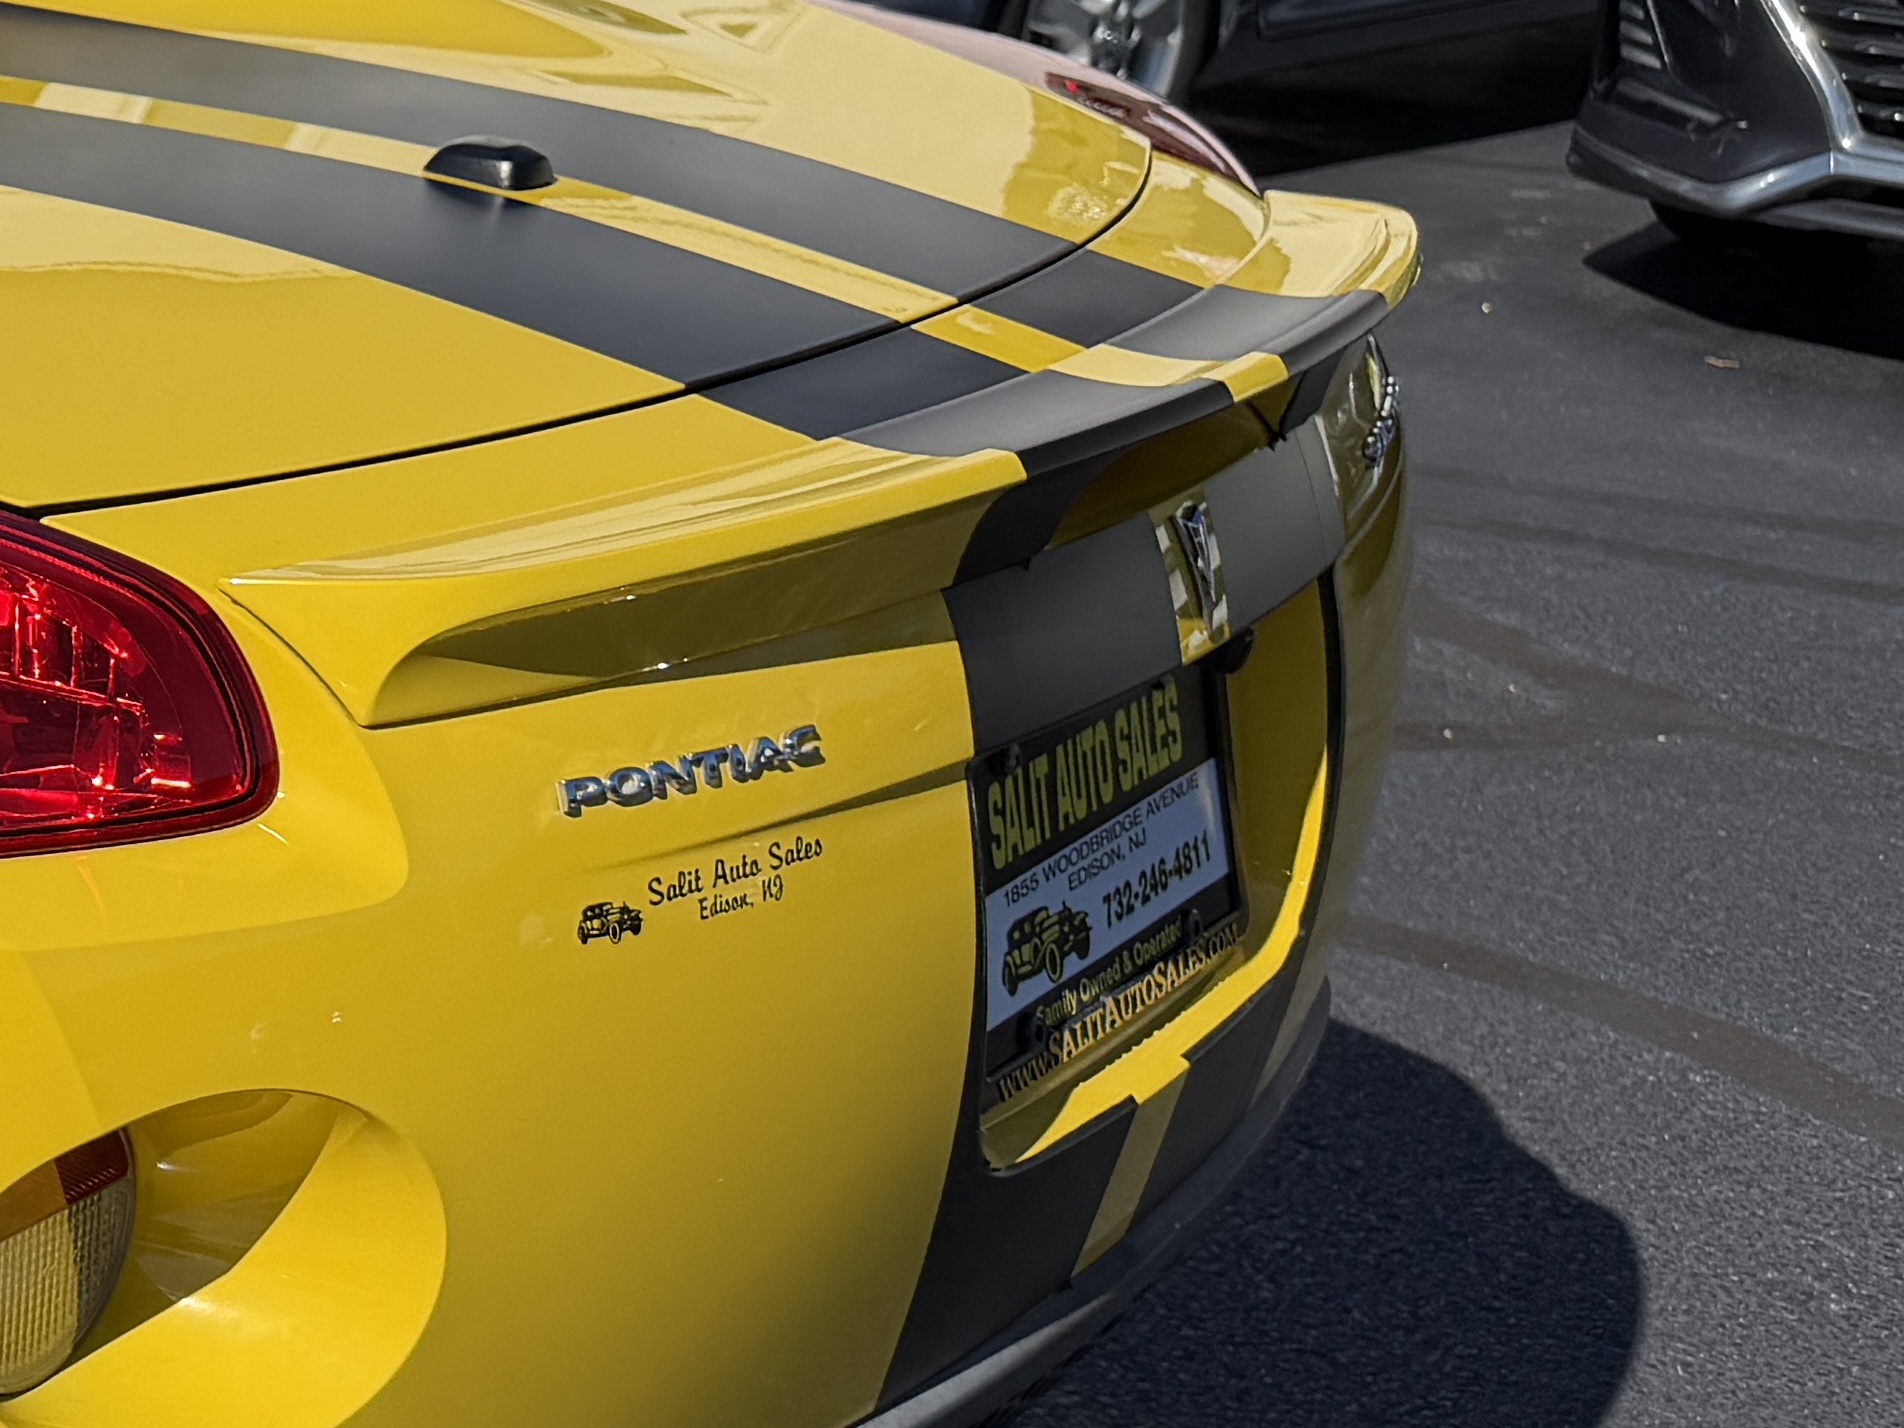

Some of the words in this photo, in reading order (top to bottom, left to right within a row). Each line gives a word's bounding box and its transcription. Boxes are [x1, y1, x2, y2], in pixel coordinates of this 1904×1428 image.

[556, 724, 826, 818] PONTIAC
[988, 753, 1051, 870] SALIT
[1055, 719, 1114, 831] AUTO
[1114, 676, 1183, 792] SALES
[647, 868, 703, 906] Salit
[712, 854, 761, 888] Auto
[768, 835, 823, 871] Sales
[1004, 878, 1039, 908] 1855
[1041, 806, 1143, 883] WOODBRIDGE
[1145, 771, 1199, 821] AVENUE
[1068, 842, 1126, 891] EDISON,
[1128, 827, 1147, 851] NJ
[1102, 828, 1211, 929] 732-246-4811
[698, 892, 754, 920] Edison,
[762, 874, 784, 902] NJ
[1079, 960, 1122, 1004] Owned
[1133, 914, 1184, 966] Operated
